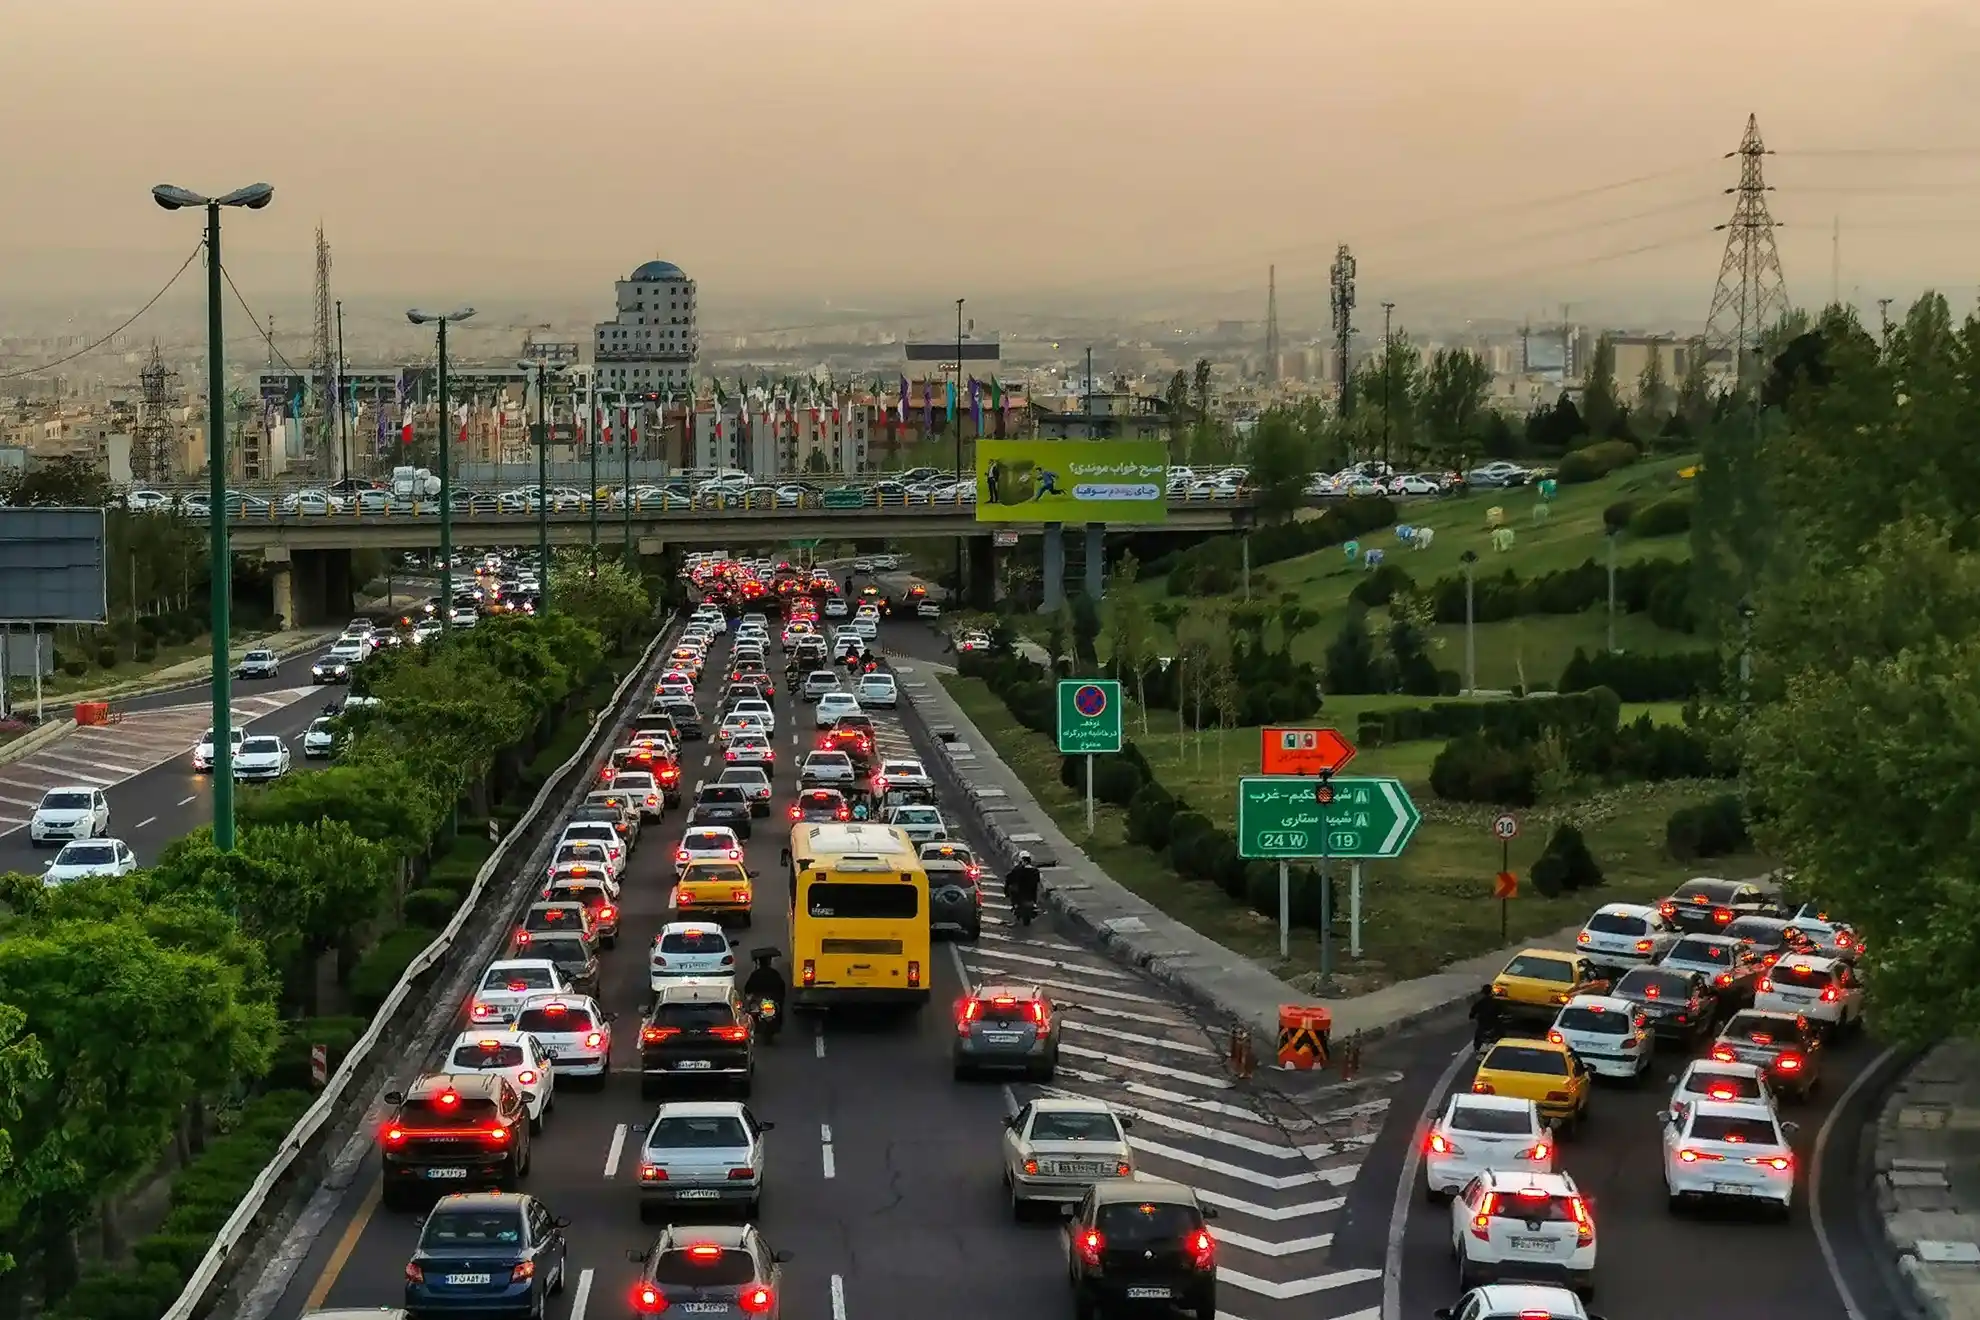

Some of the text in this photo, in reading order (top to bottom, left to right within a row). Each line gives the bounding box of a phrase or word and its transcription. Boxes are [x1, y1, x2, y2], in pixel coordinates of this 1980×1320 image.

[1281, 813, 1318, 827] ستاری
[1498, 821, 1513, 834] 30
[1263, 834, 1304, 847] 24 W
[1336, 834, 1354, 847] 19
